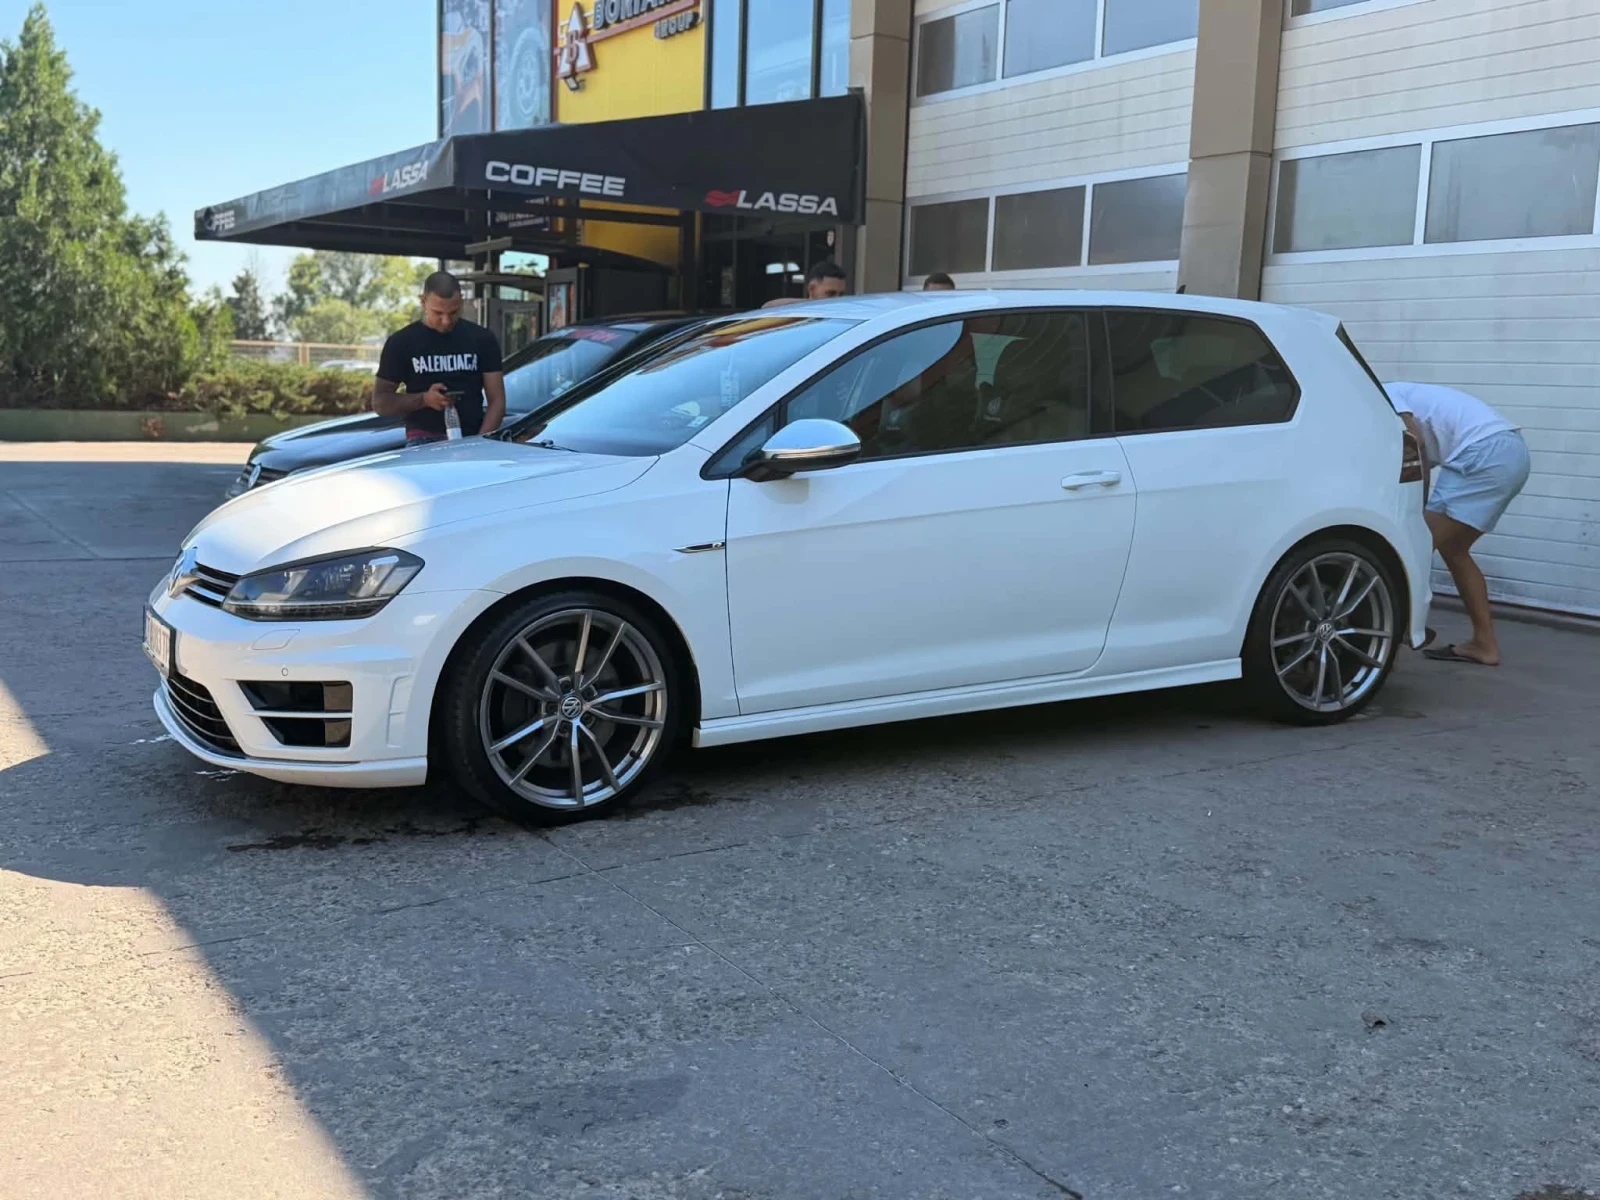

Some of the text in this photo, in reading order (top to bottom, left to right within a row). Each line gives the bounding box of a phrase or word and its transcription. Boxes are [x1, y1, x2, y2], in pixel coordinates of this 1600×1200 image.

[382, 160, 429, 193] LASSA
[485, 160, 626, 197] COFFEE
[736, 189, 838, 216] LASSA
[412, 353, 478, 374] BALENCIAGA
